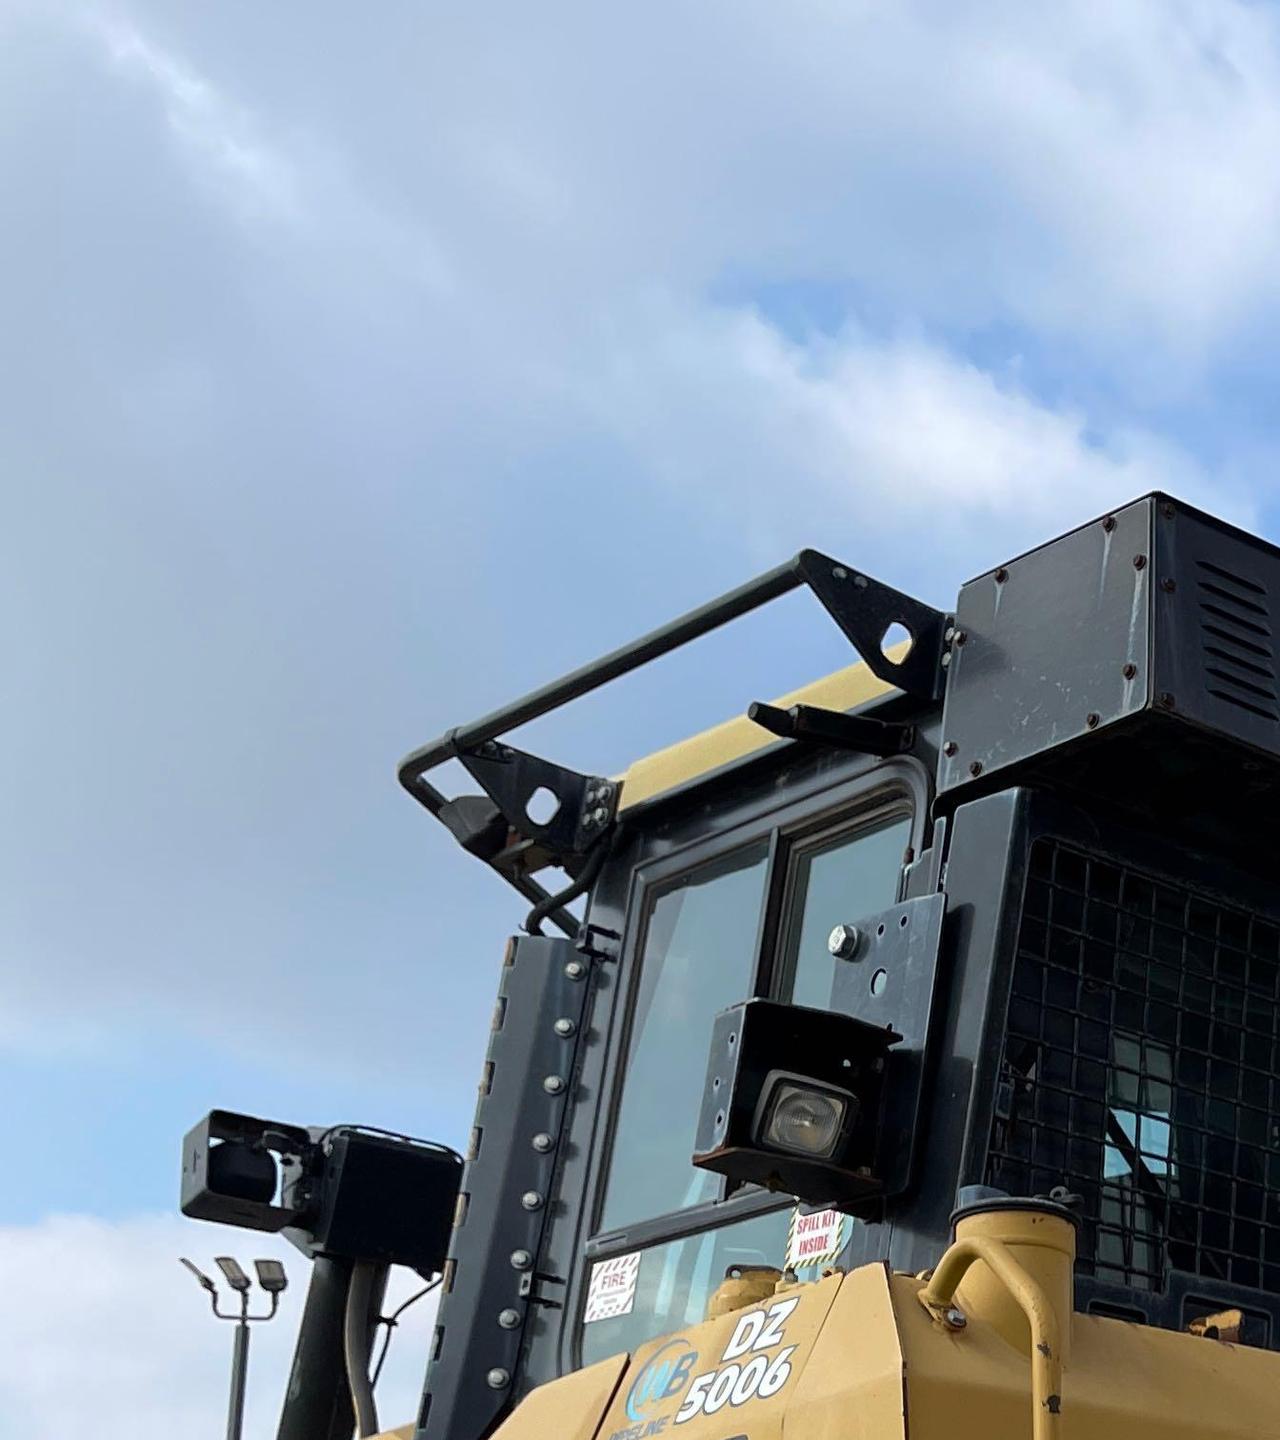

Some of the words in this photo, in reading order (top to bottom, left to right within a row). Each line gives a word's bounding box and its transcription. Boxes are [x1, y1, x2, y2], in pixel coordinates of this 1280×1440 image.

[797, 1215, 820, 1235] SPILL
[822, 1211, 836, 1228] KIT
[799, 1234, 829, 1256] INSIDE
[601, 1270, 627, 1290] FIRE
[720, 1297, 800, 1363] DZ
[674, 1344, 799, 1425] 5006
